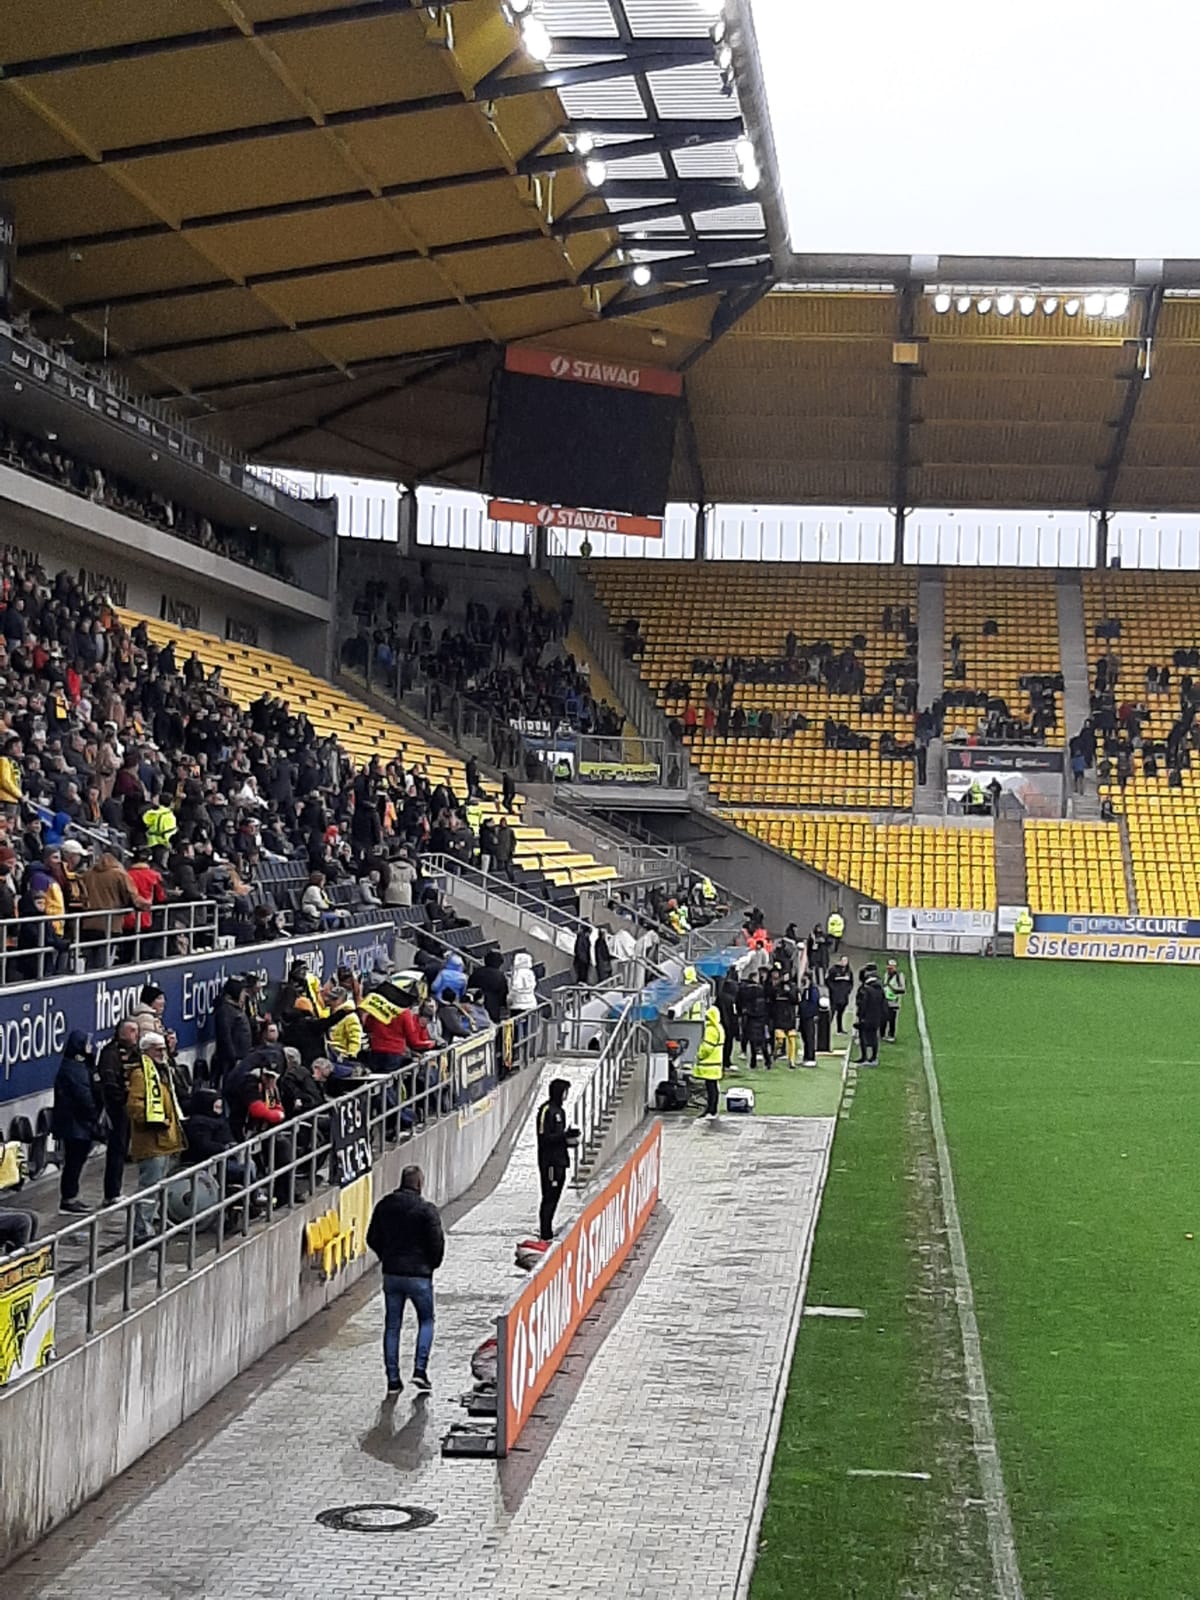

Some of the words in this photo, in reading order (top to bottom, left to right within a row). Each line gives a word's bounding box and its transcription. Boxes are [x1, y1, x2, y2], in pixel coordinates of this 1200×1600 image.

[572, 360, 640, 387] STAWAG
[557, 510, 618, 531] STAWAG
[528, 1250, 572, 1388] STAWAG
[586, 1184, 626, 1290] STAWAG
